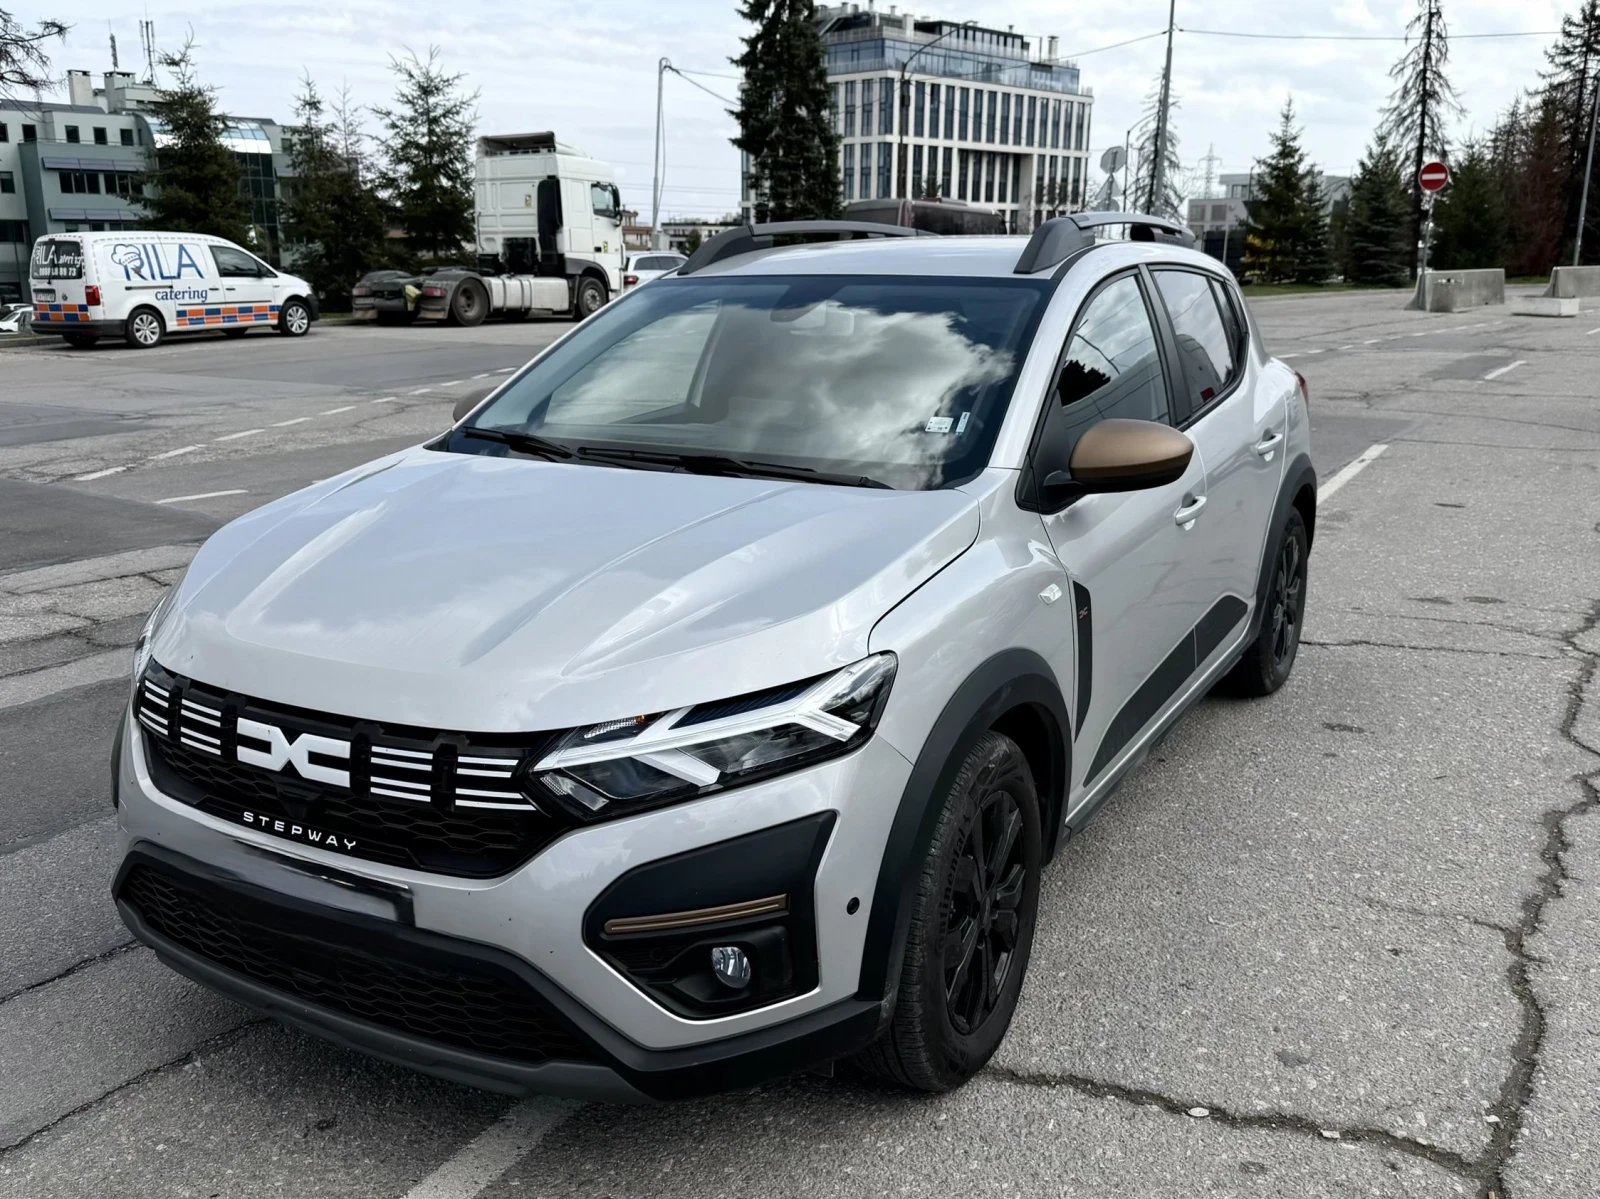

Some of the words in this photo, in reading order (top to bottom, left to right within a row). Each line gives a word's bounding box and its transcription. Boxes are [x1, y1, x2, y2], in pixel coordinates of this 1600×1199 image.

[69, 267, 77, 276] 73
[111, 243, 205, 281] RILA
[155, 286, 208, 303] catering
[243, 811, 356, 850] STEPWAY
